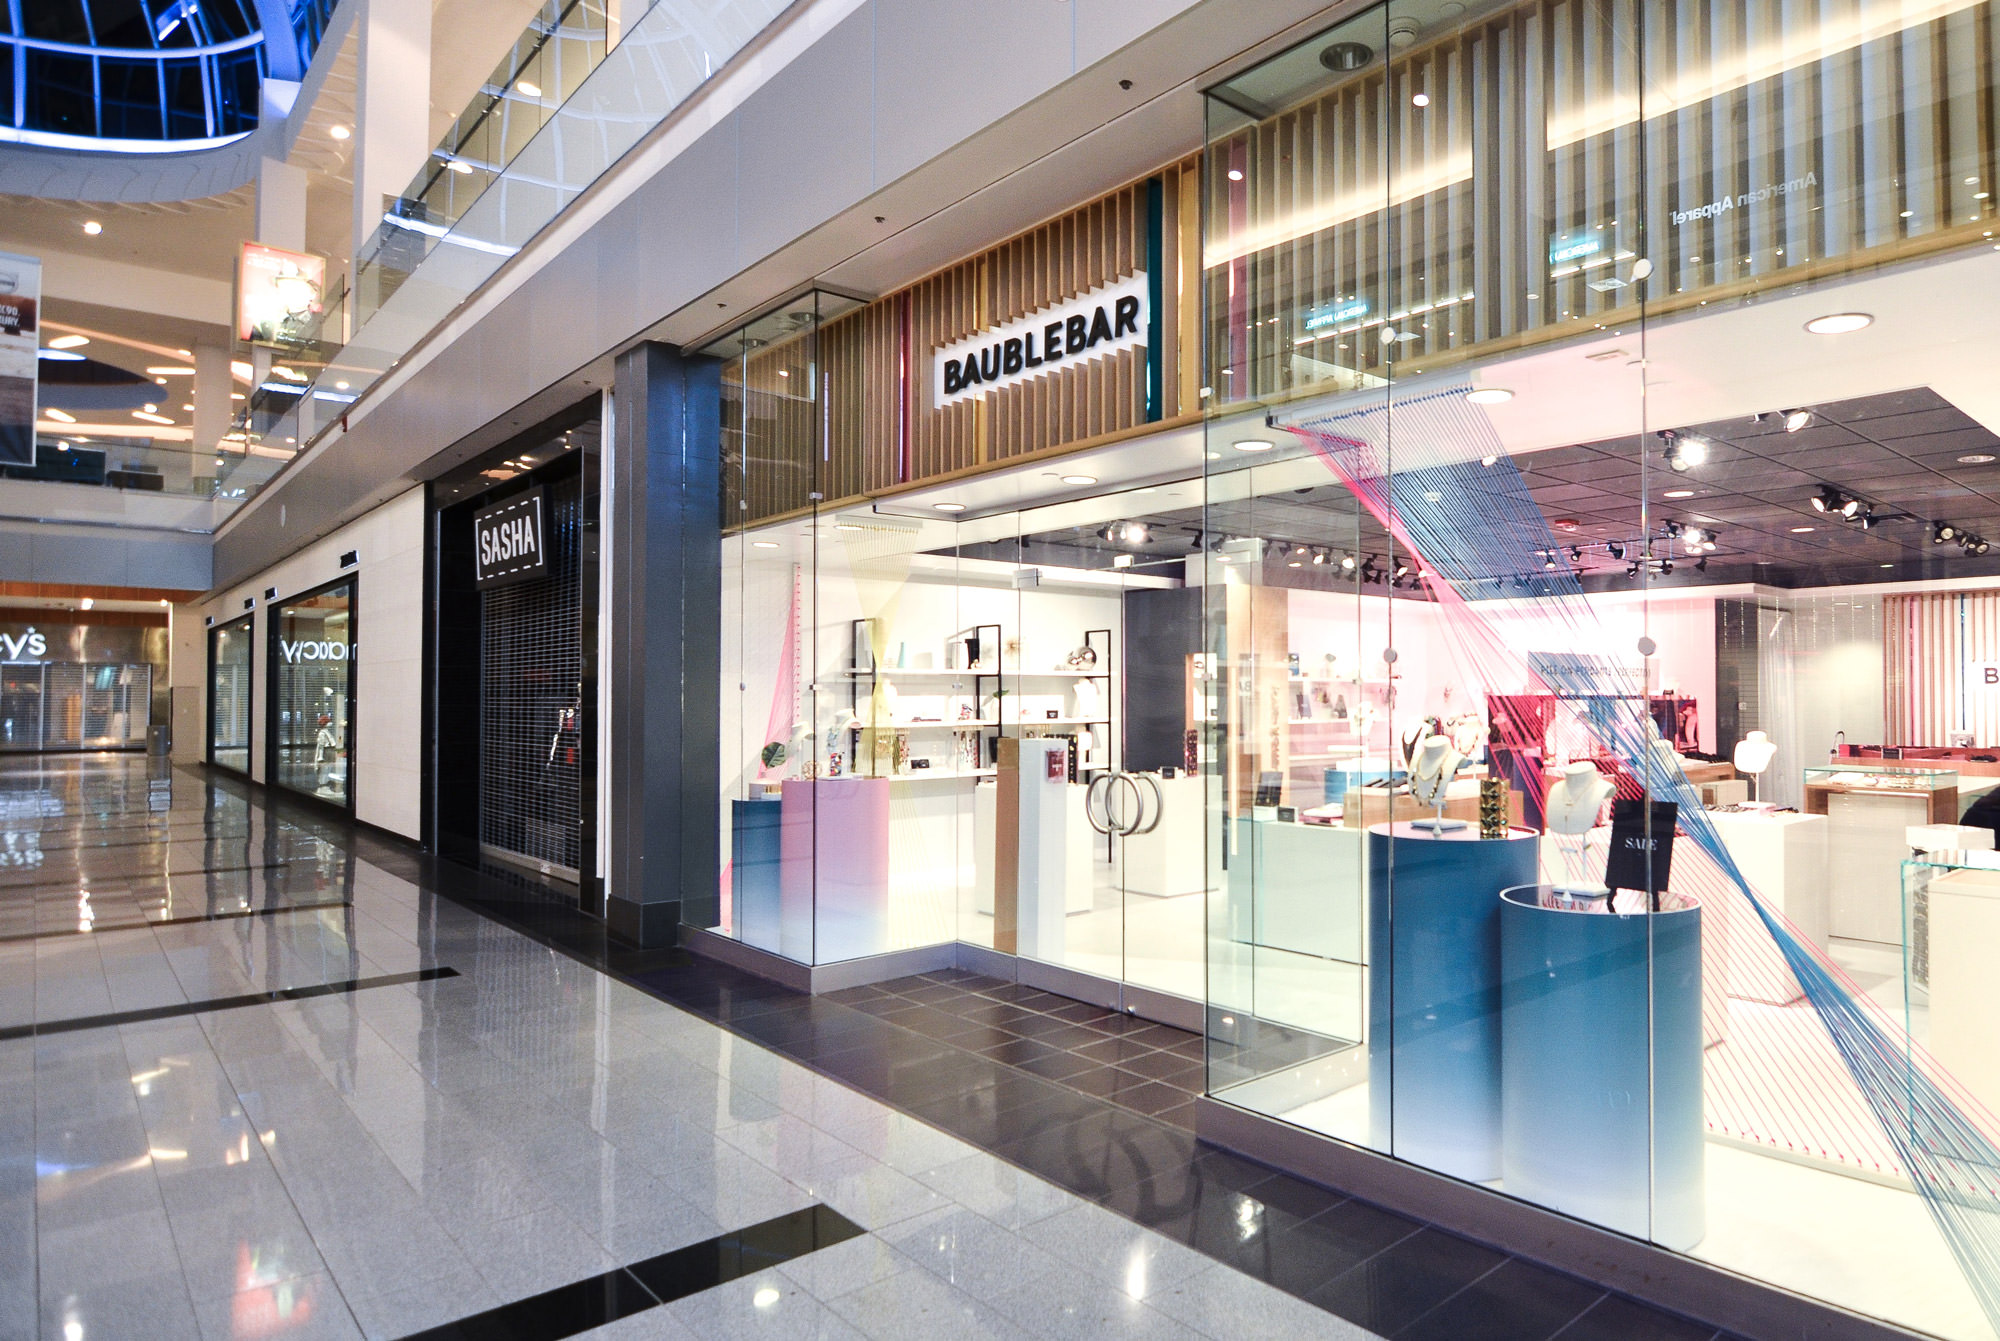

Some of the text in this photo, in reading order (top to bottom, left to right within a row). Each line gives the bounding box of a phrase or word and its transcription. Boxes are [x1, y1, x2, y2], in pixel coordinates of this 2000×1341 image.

[0, 304, 21, 317] C90.
[943, 295, 1139, 395] BAUBLEBAR
[481, 515, 536, 566] SASHA
[1624, 837, 1658, 851] SALE
